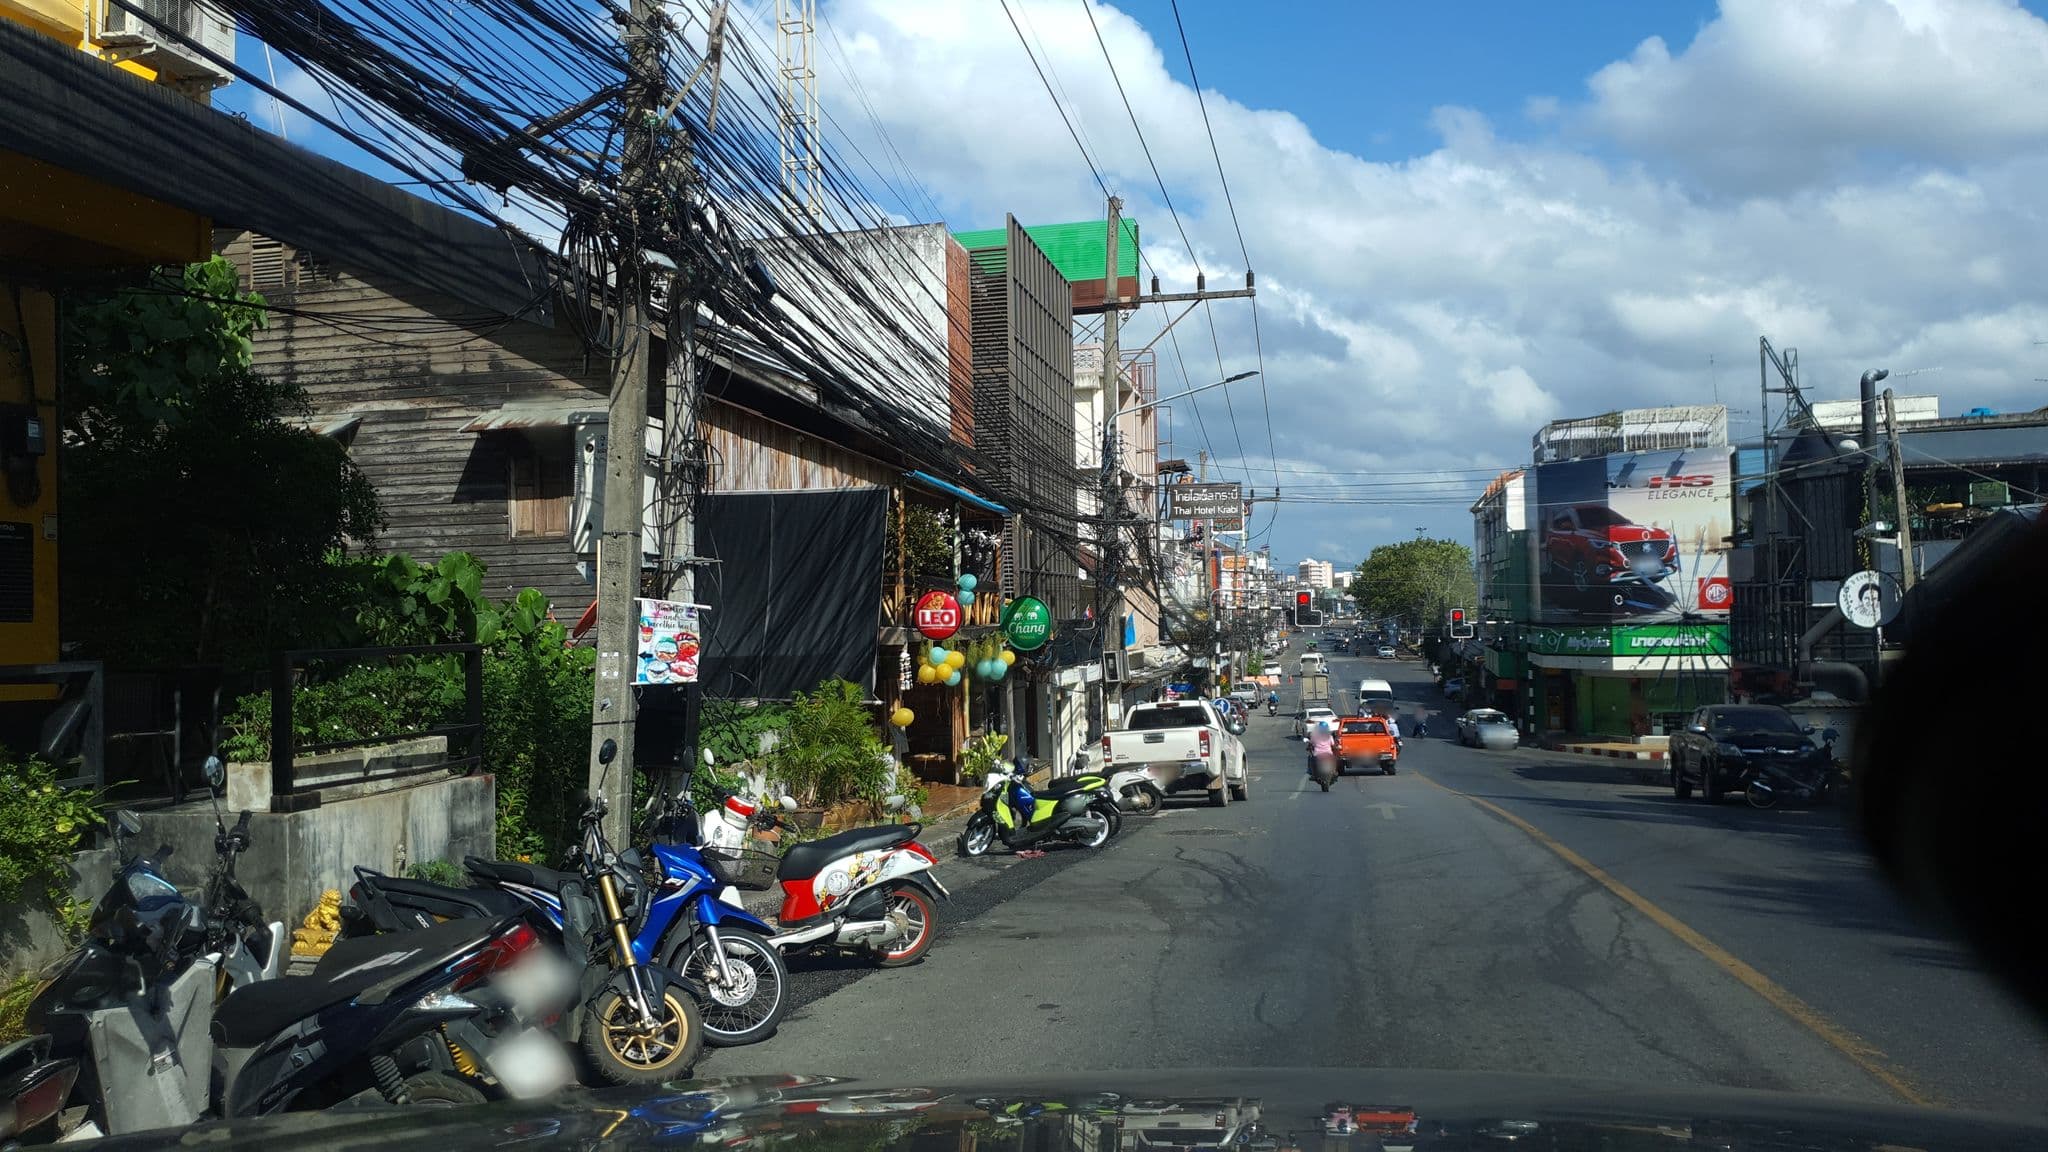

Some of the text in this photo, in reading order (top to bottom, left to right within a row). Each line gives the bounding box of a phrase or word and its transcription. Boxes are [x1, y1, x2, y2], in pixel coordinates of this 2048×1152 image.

[1648, 488, 1714, 500] ELEGANCE
[1173, 505, 1238, 516] Thai Hotel Krabi
[920, 611, 954, 625] LEO
[1008, 622, 1045, 634] Chang
